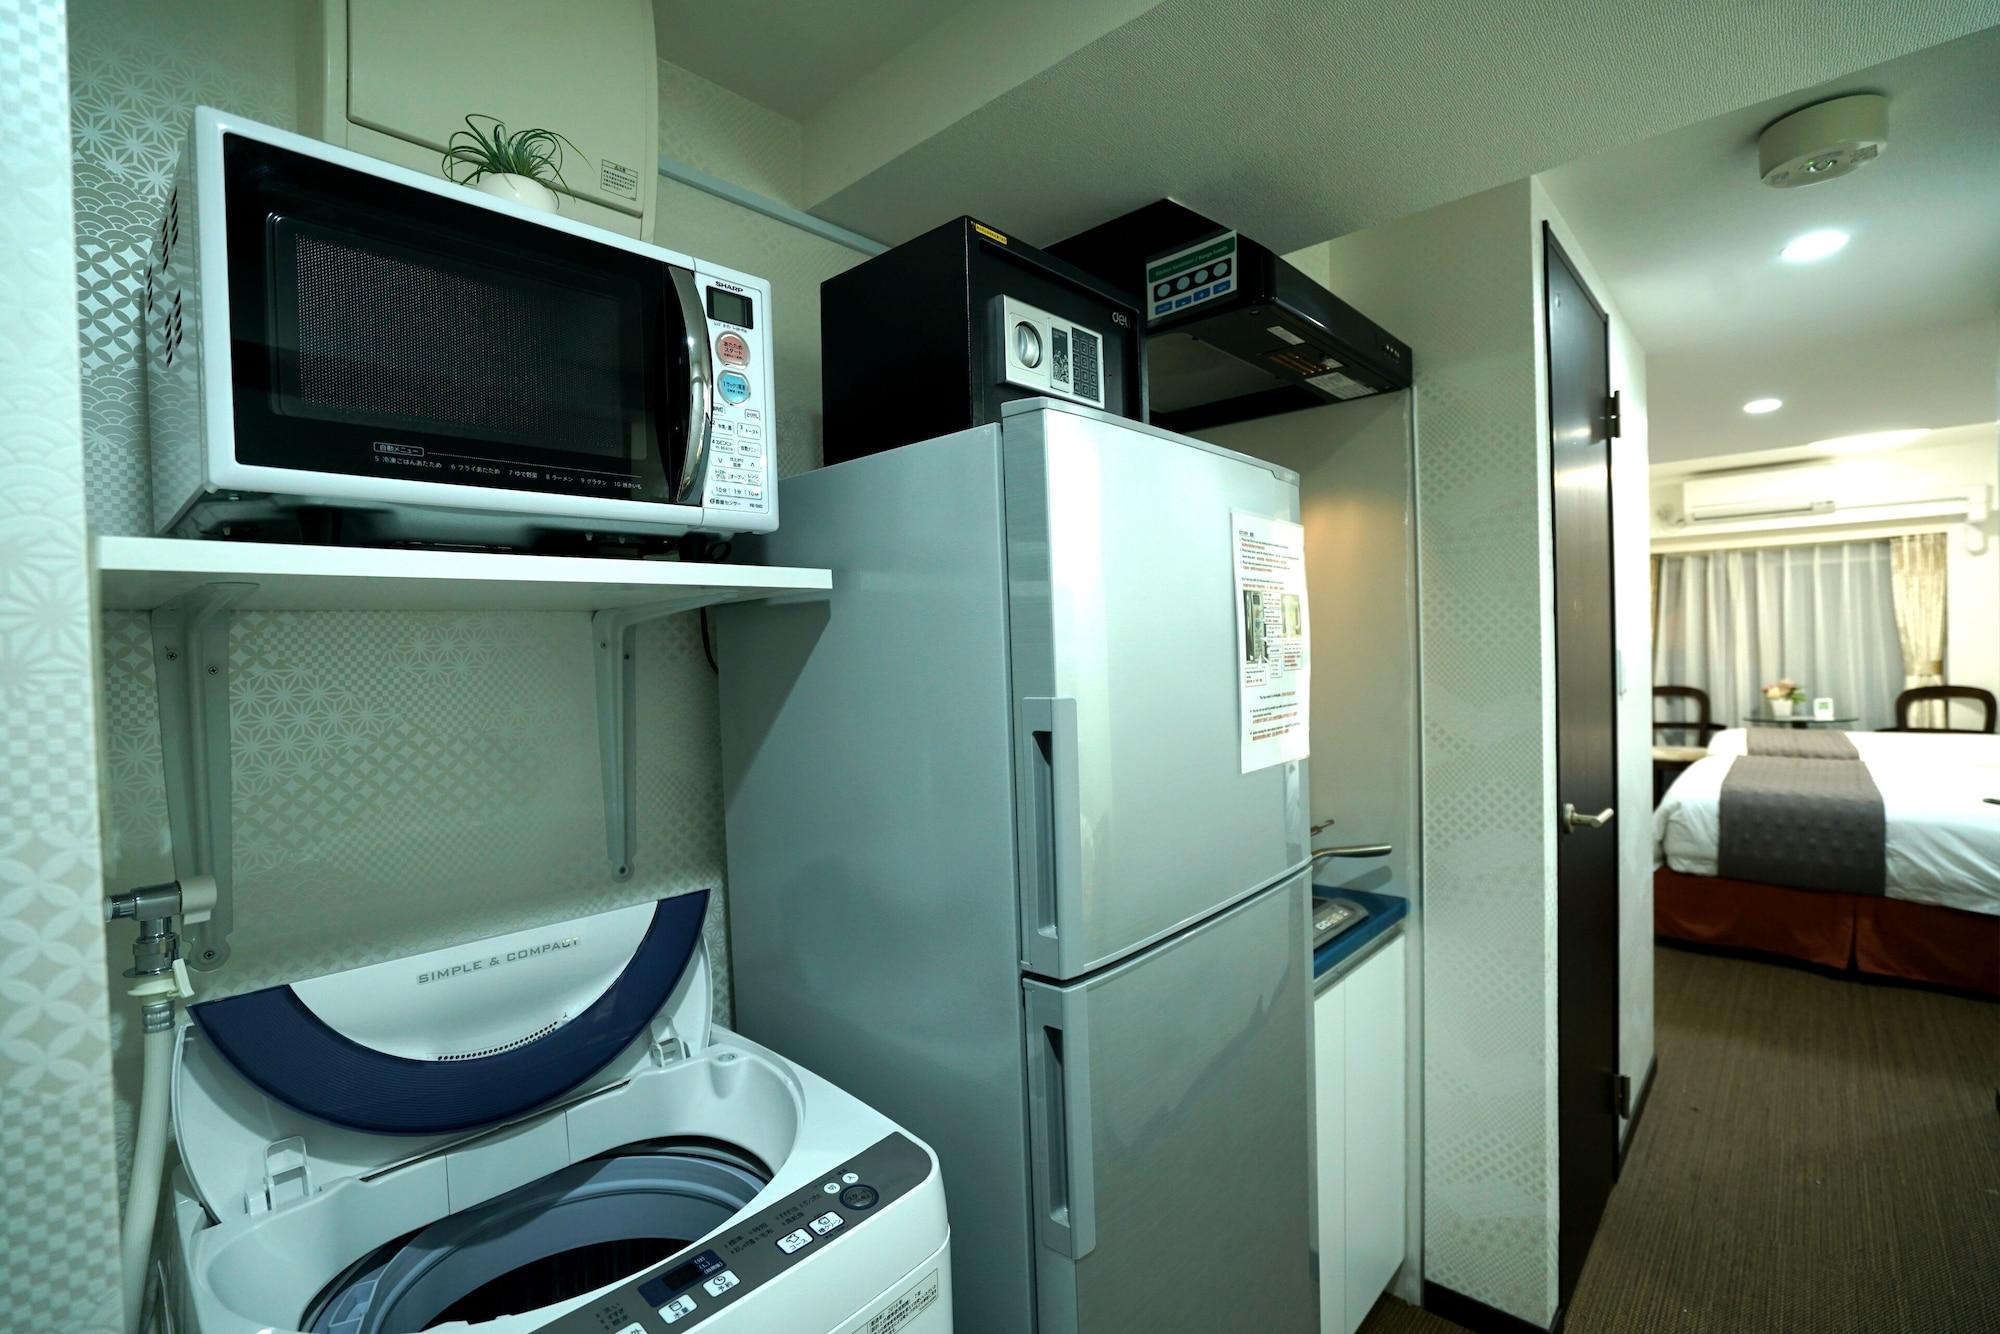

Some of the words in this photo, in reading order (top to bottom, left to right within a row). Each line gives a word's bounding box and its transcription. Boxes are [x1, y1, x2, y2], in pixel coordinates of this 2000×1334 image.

[715, 281, 744, 293] SHARP
[724, 347, 743, 356] スタート
[380, 444, 419, 454] 自動メニュー
[450, 463, 457, 471] 6
[458, 464, 501, 474] フライあたため
[551, 474, 574, 482] ラーメン
[586, 478, 607, 486] グラタン
[418, 960, 483, 984] SIMPLE
[489, 957, 500, 967] &
[506, 937, 580, 962] COMPACT
[789, 1238, 808, 1251] コース
[718, 1281, 734, 1292] 予約
[674, 1306, 689, 1319] 水量
